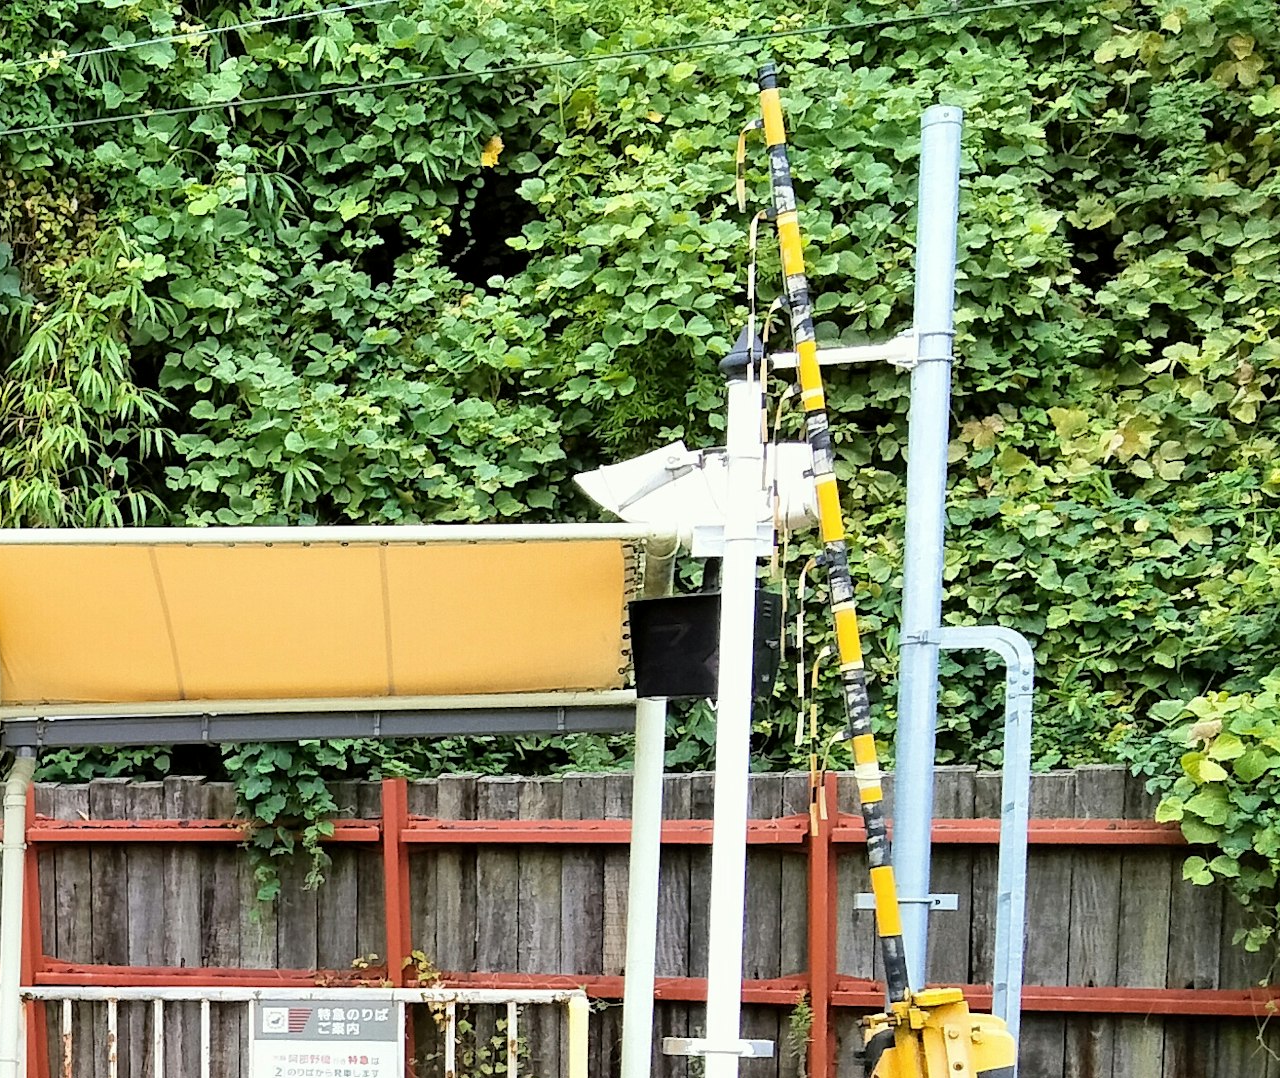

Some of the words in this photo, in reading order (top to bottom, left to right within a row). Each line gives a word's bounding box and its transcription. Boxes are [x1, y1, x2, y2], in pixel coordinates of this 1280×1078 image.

[317, 1008, 389, 1021] 特急のりば
[317, 1022, 360, 1035] ご案内
